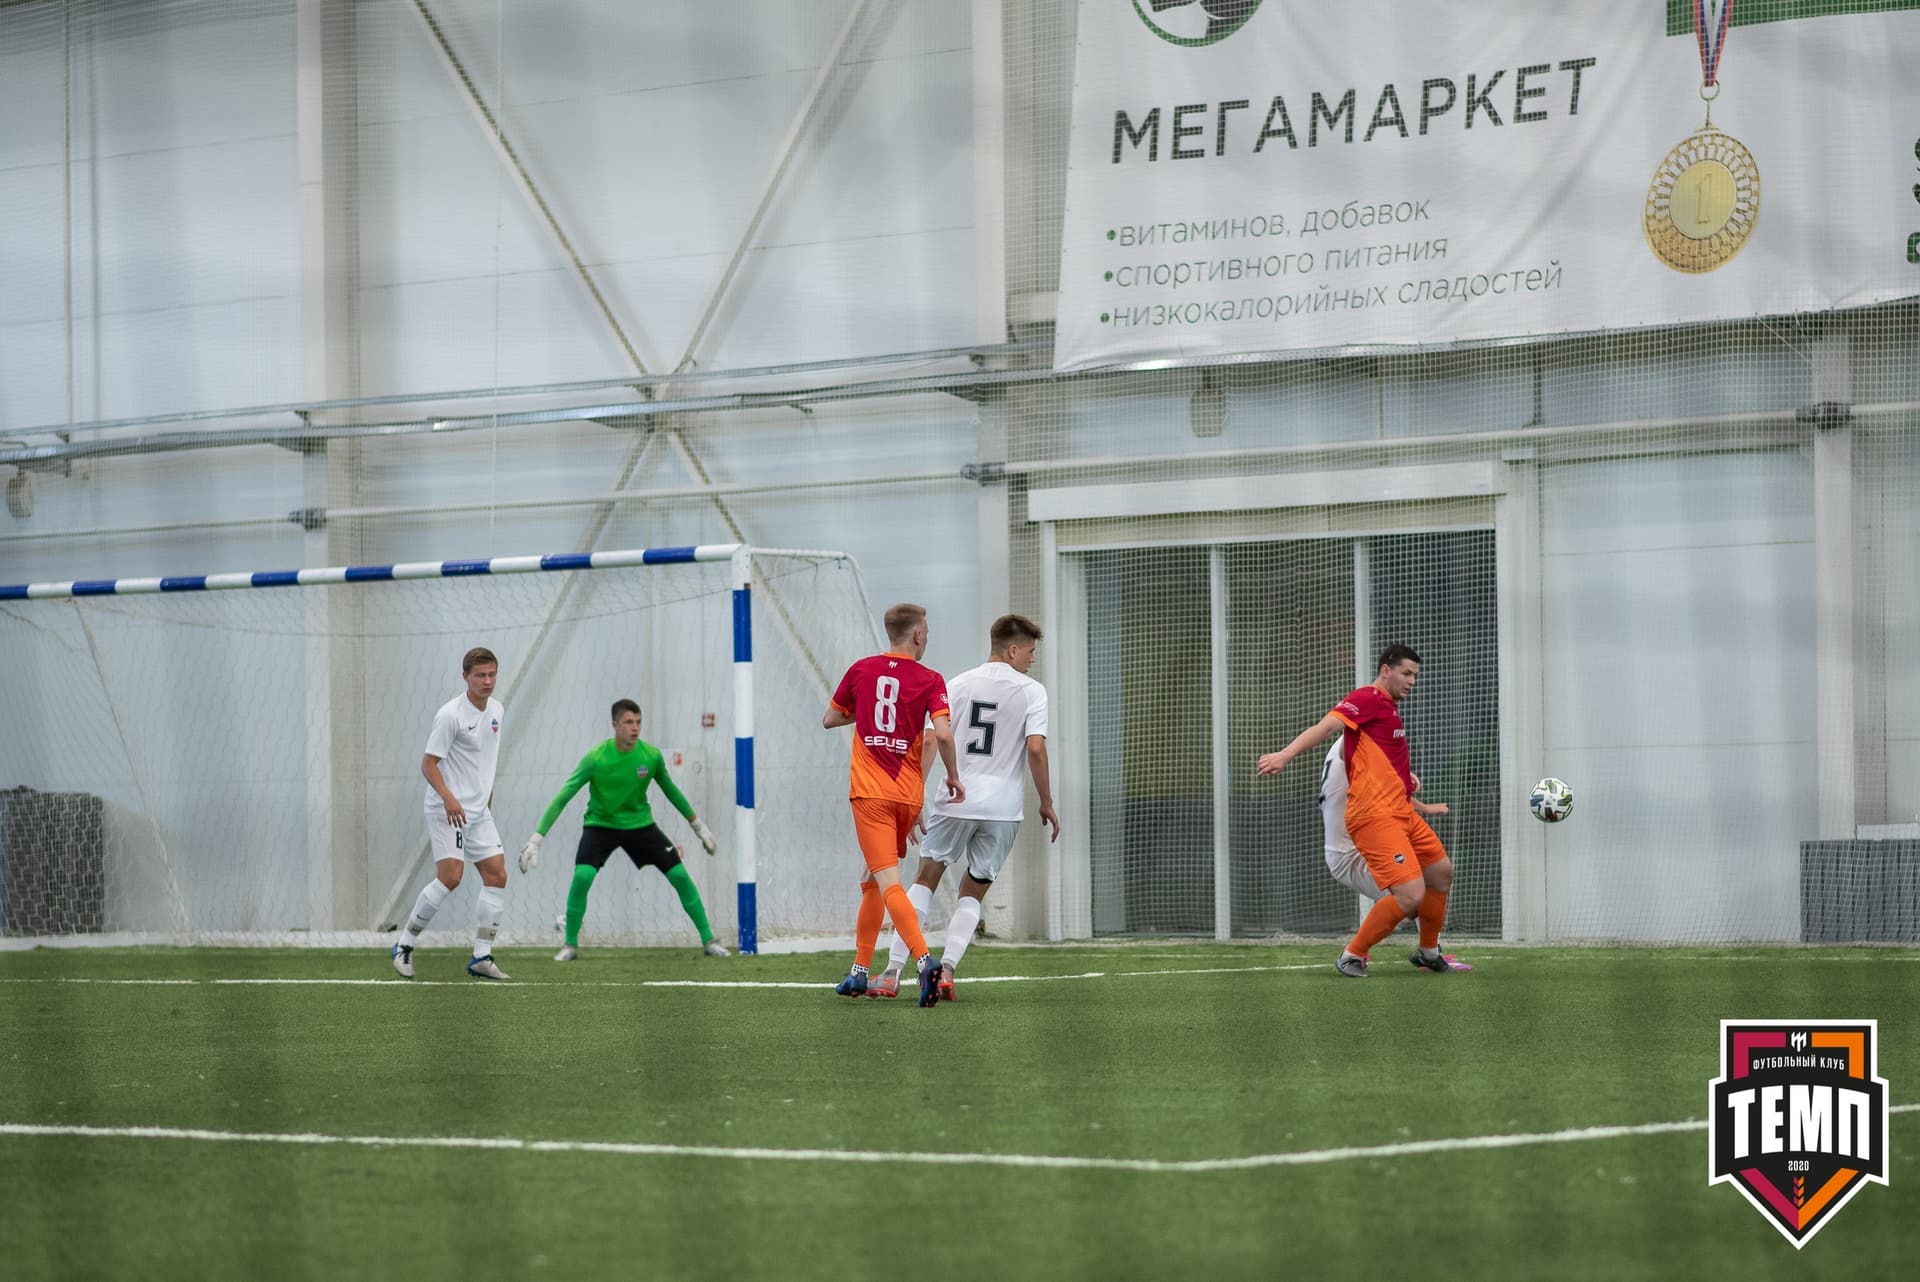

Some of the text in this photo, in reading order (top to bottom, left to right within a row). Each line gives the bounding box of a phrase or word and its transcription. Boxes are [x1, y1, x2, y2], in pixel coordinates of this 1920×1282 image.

[1112, 57, 1597, 164] МЕГАМАРКЕТ
[1119, 200, 1430, 247] витаминов, добавок
[1116, 238, 1448, 289] спортивного питания
[1113, 259, 1563, 328] низкокалорийных сладостей
[874, 675, 900, 733] 8
[966, 700, 998, 757] 5
[864, 735, 908, 750] SEUS
[456, 831, 463, 849] 8
